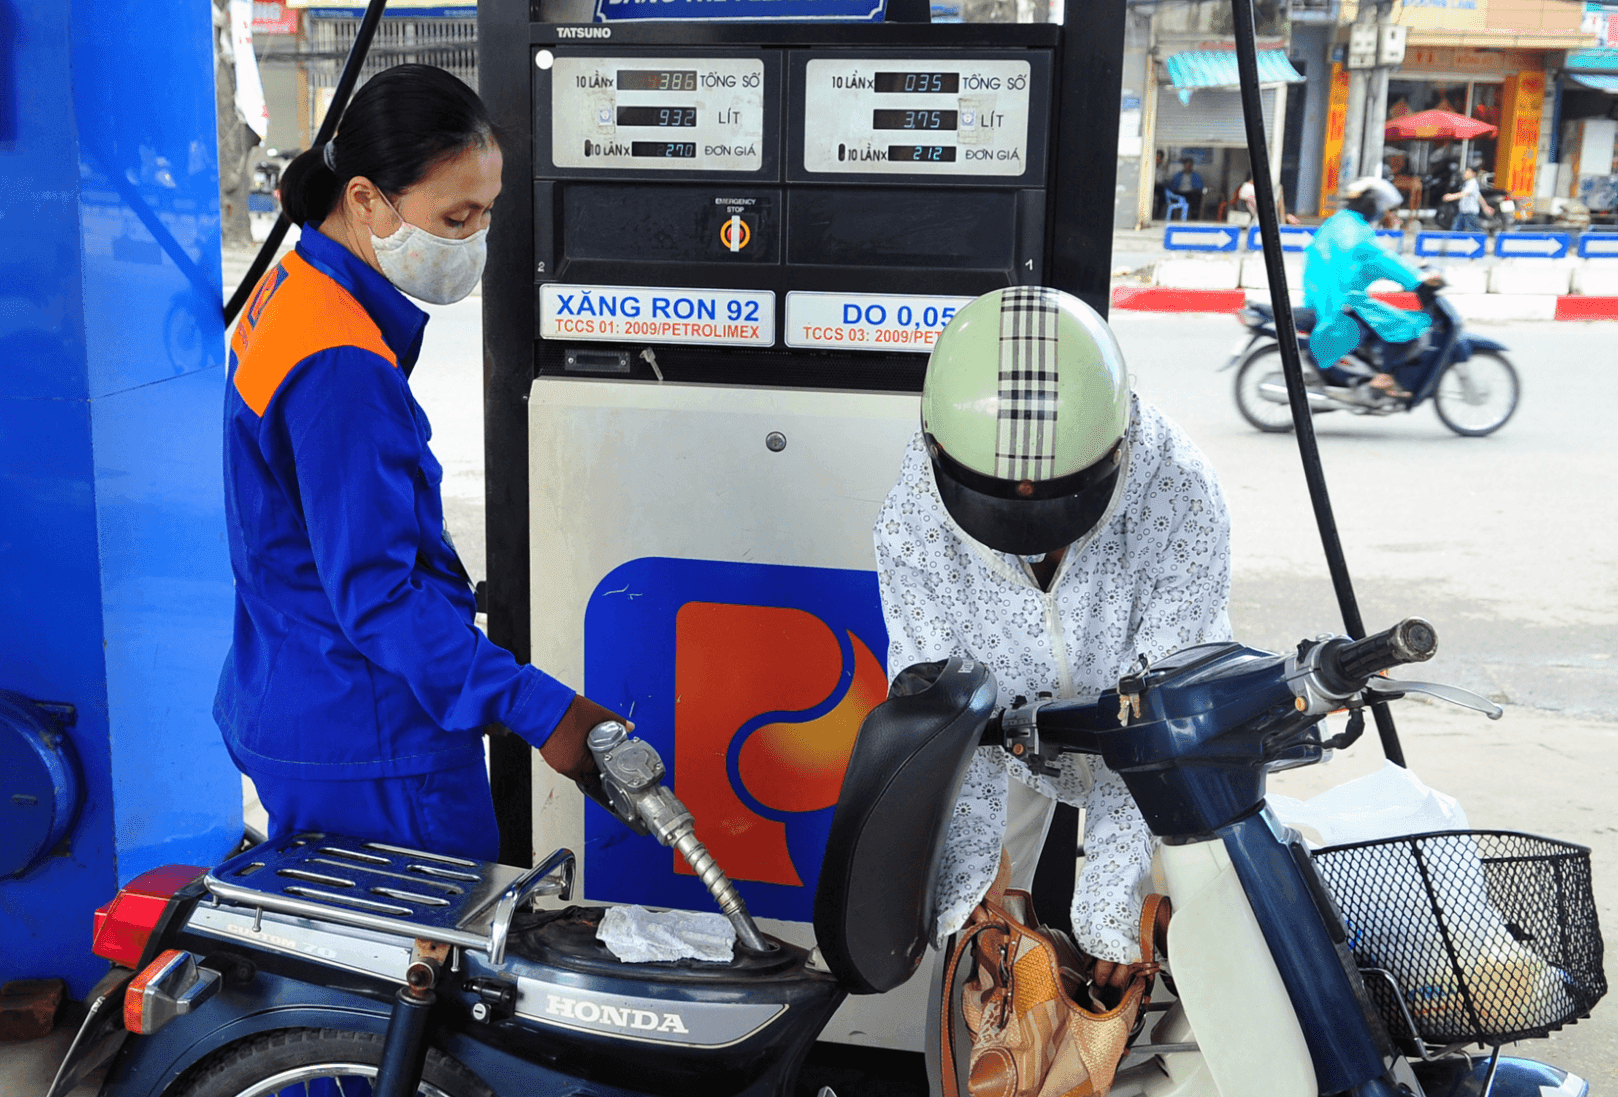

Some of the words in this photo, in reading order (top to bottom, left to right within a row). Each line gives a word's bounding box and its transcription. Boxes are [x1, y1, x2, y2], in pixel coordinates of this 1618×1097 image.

[556, 27, 612, 39] TATSUNO
[576, 76, 587, 88] 10
[659, 73, 695, 89] 386
[742, 72, 761, 88] SỐ
[832, 76, 843, 89] 10
[904, 74, 942, 92] 035
[1007, 74, 1027, 90] SỐ
[659, 109, 695, 126] 932
[718, 108, 741, 124] LÍT
[734, 143, 756, 157] GIÁ
[848, 148, 858, 161] 10
[913, 146, 942, 160] 212
[997, 146, 1020, 161] GIÁ
[715, 197, 756, 205] EMERGENCY
[537, 261, 546, 273] 2
[1025, 259, 1034, 270] 1
[557, 289, 641, 318] XĂNG
[652, 297, 716, 320] RON
[727, 300, 760, 321] 92
[843, 303, 887, 325] DO
[555, 318, 595, 334] TCCS
[599, 320, 620, 334] 01:
[625, 321, 760, 339] 2009/PETROLIMEX
[803, 326, 844, 341] TCCS
[849, 327, 871, 342] 03:
[226, 923, 297, 948] CUSTOM
[303, 942, 338, 959] 70
[545, 994, 689, 1034] HONDA
